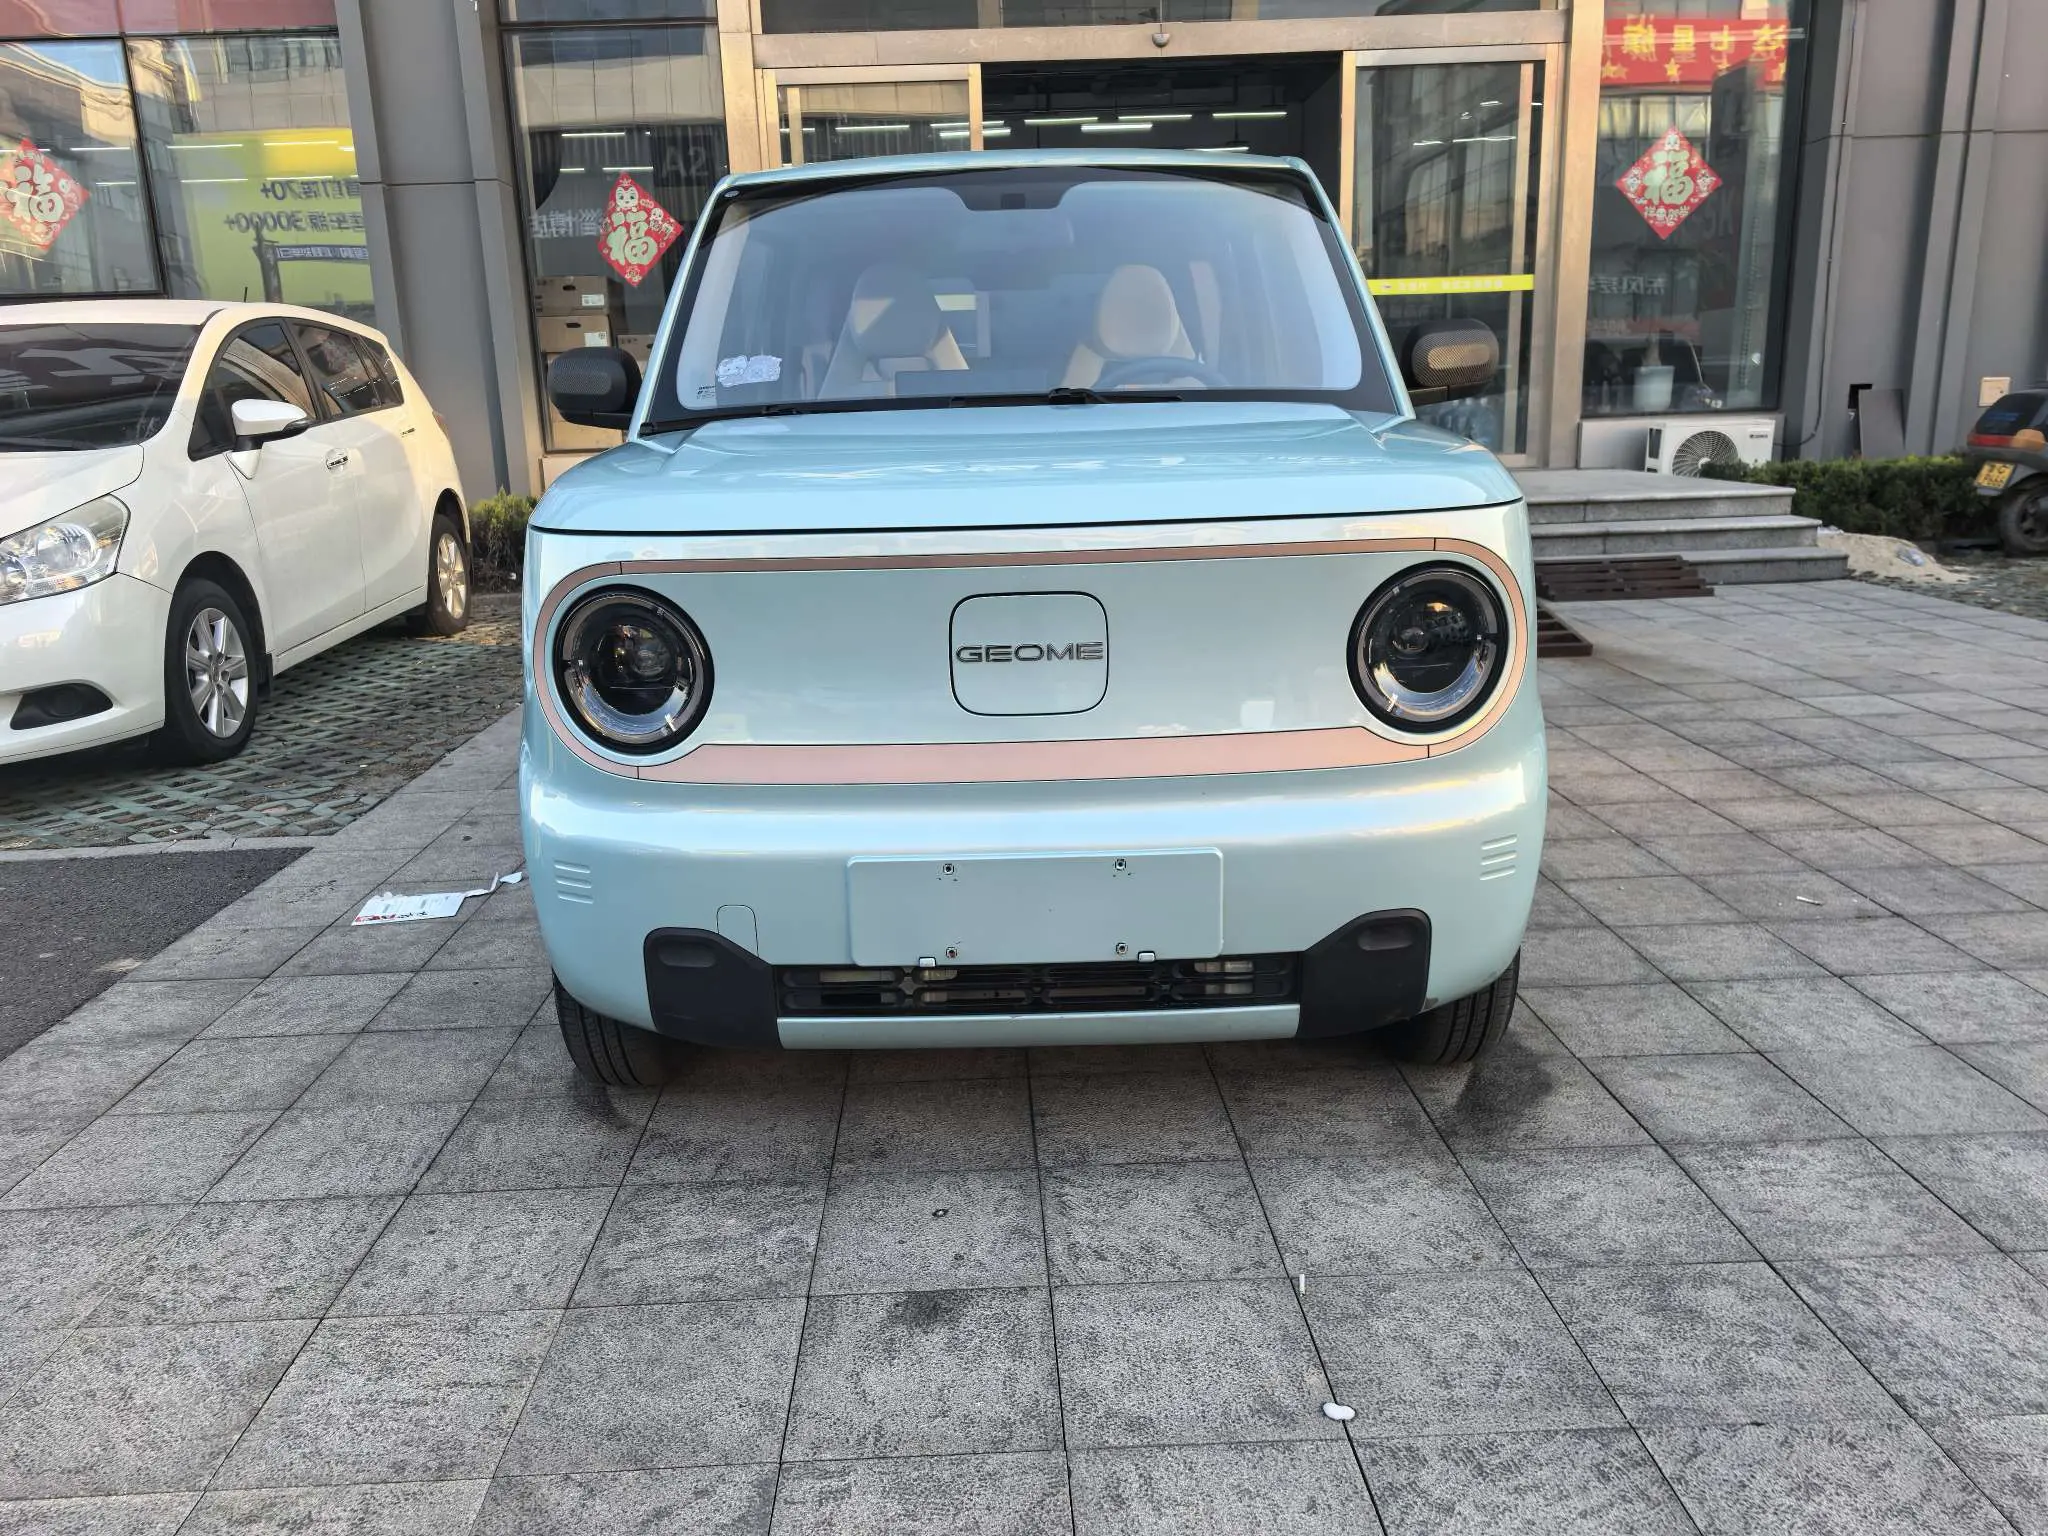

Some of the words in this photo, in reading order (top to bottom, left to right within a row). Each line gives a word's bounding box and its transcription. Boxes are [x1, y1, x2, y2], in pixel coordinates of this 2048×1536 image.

[5, 163, 65, 223] 福
[1643, 149, 1695, 206] 福
[606, 210, 659, 267] 福
[955, 641, 1103, 663] GEOME
